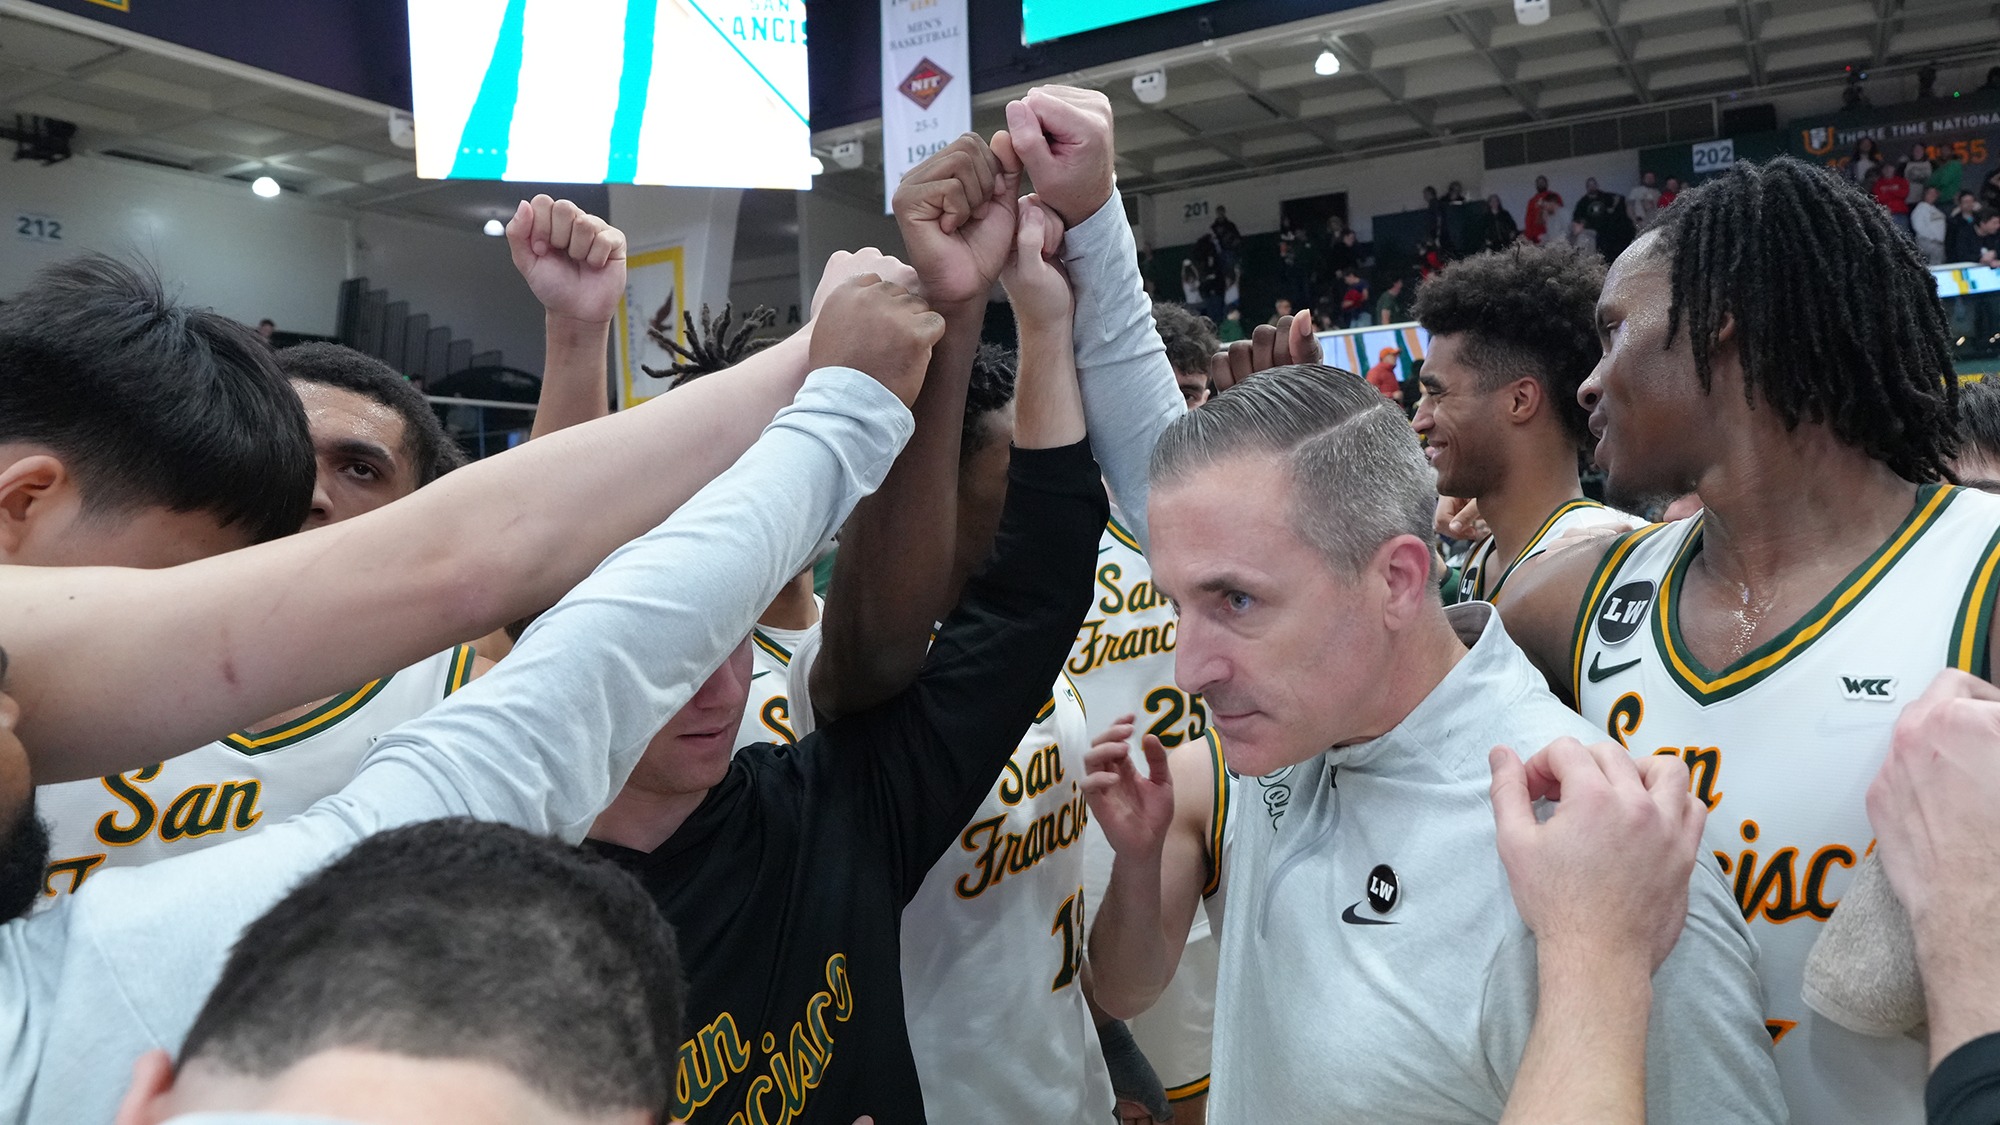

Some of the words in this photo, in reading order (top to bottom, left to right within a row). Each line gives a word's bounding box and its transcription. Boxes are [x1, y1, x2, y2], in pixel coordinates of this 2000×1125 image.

[890, 26, 959, 50] BASKETBALL
[911, 76, 942, 92] NIT
[1838, 127, 1886, 145] THREE
[1892, 121, 1926, 138] TIME
[1694, 146, 1731, 167] 202
[1184, 201, 1208, 218] 201
[18, 216, 62, 240] 212
[1602, 597, 1649, 624] LW
[1842, 676, 1892, 696] WCC
[1143, 686, 1207, 749] 25
[94, 761, 263, 848] San
[1369, 875, 1395, 902] LW
[670, 1011, 750, 1121] an
